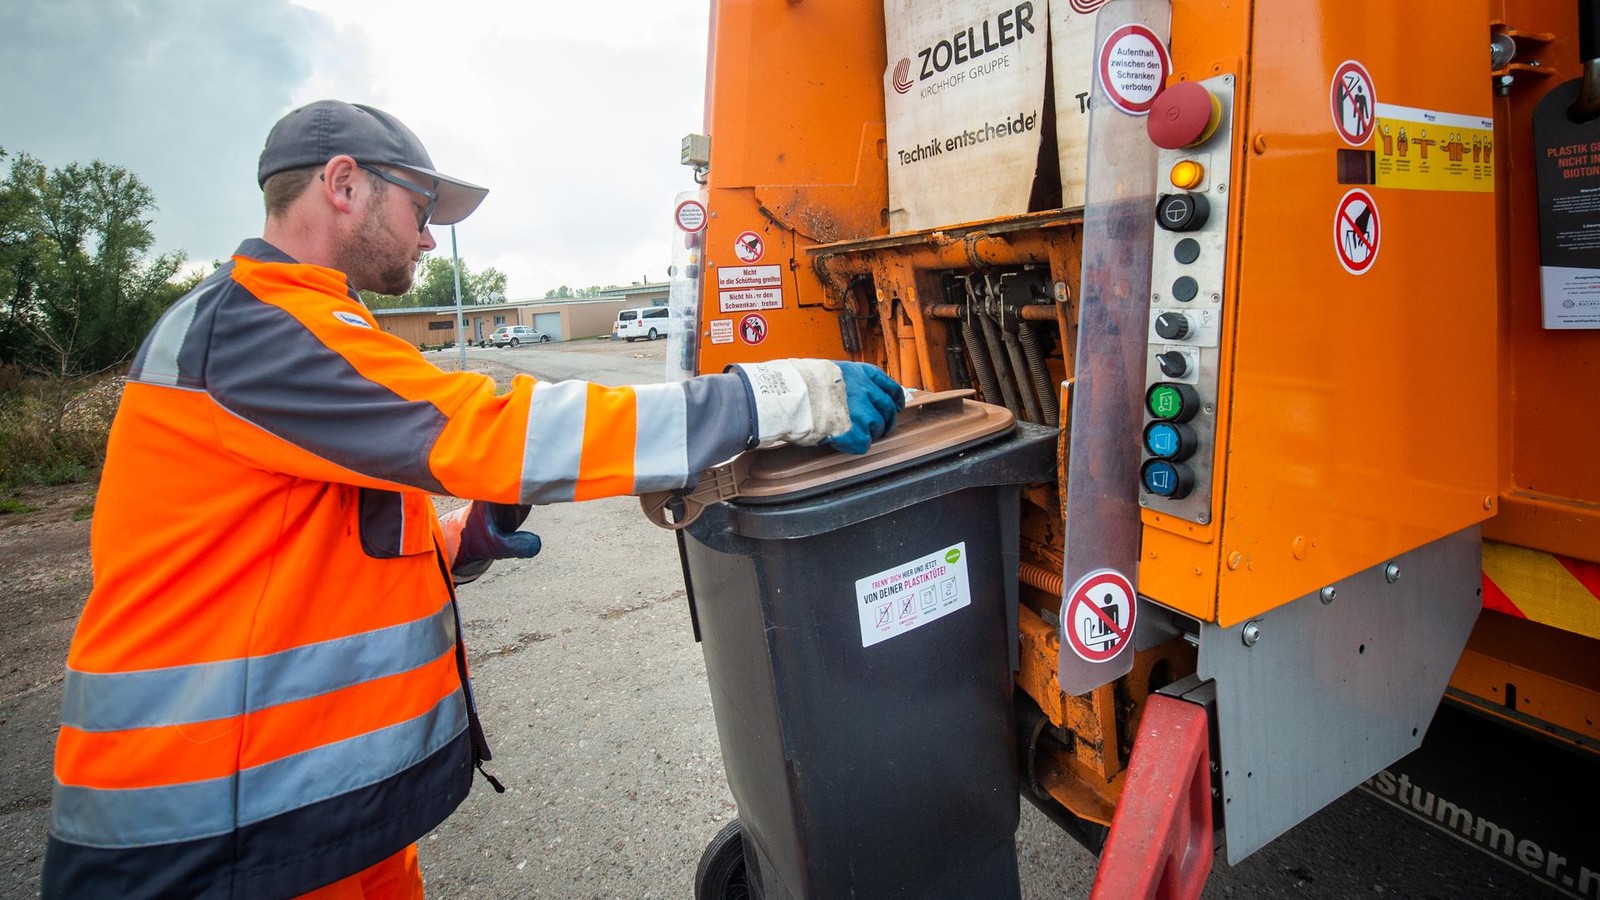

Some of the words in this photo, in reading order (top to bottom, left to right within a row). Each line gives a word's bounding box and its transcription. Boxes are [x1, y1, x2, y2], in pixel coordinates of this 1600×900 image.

[918, 1, 1035, 81] ZOELLER
[1117, 48, 1154, 57] Aufenthalt
[1111, 60, 1145, 68] zwischen
[1147, 61, 1160, 69] den
[920, 71, 966, 99] KIRCHHOFF
[969, 54, 1010, 80] GRUPPE
[1117, 71, 1155, 80] Schranken
[1121, 83, 1152, 92] verboten
[898, 137, 942, 166] Technik
[945, 109, 1037, 152] entscheidet
[1547, 143, 1588, 158] PLASTIK
[1558, 155, 1587, 168] NICHT
[902, 569, 914, 579] HIER
[914, 565, 924, 574] UND
[924, 560, 937, 570] JETZT
[863, 592, 878, 604] VON
[880, 583, 903, 599] DEINER
[904, 566, 946, 589] PLASTIKTÜTE!
[1364, 769, 1600, 895] stummer.n
